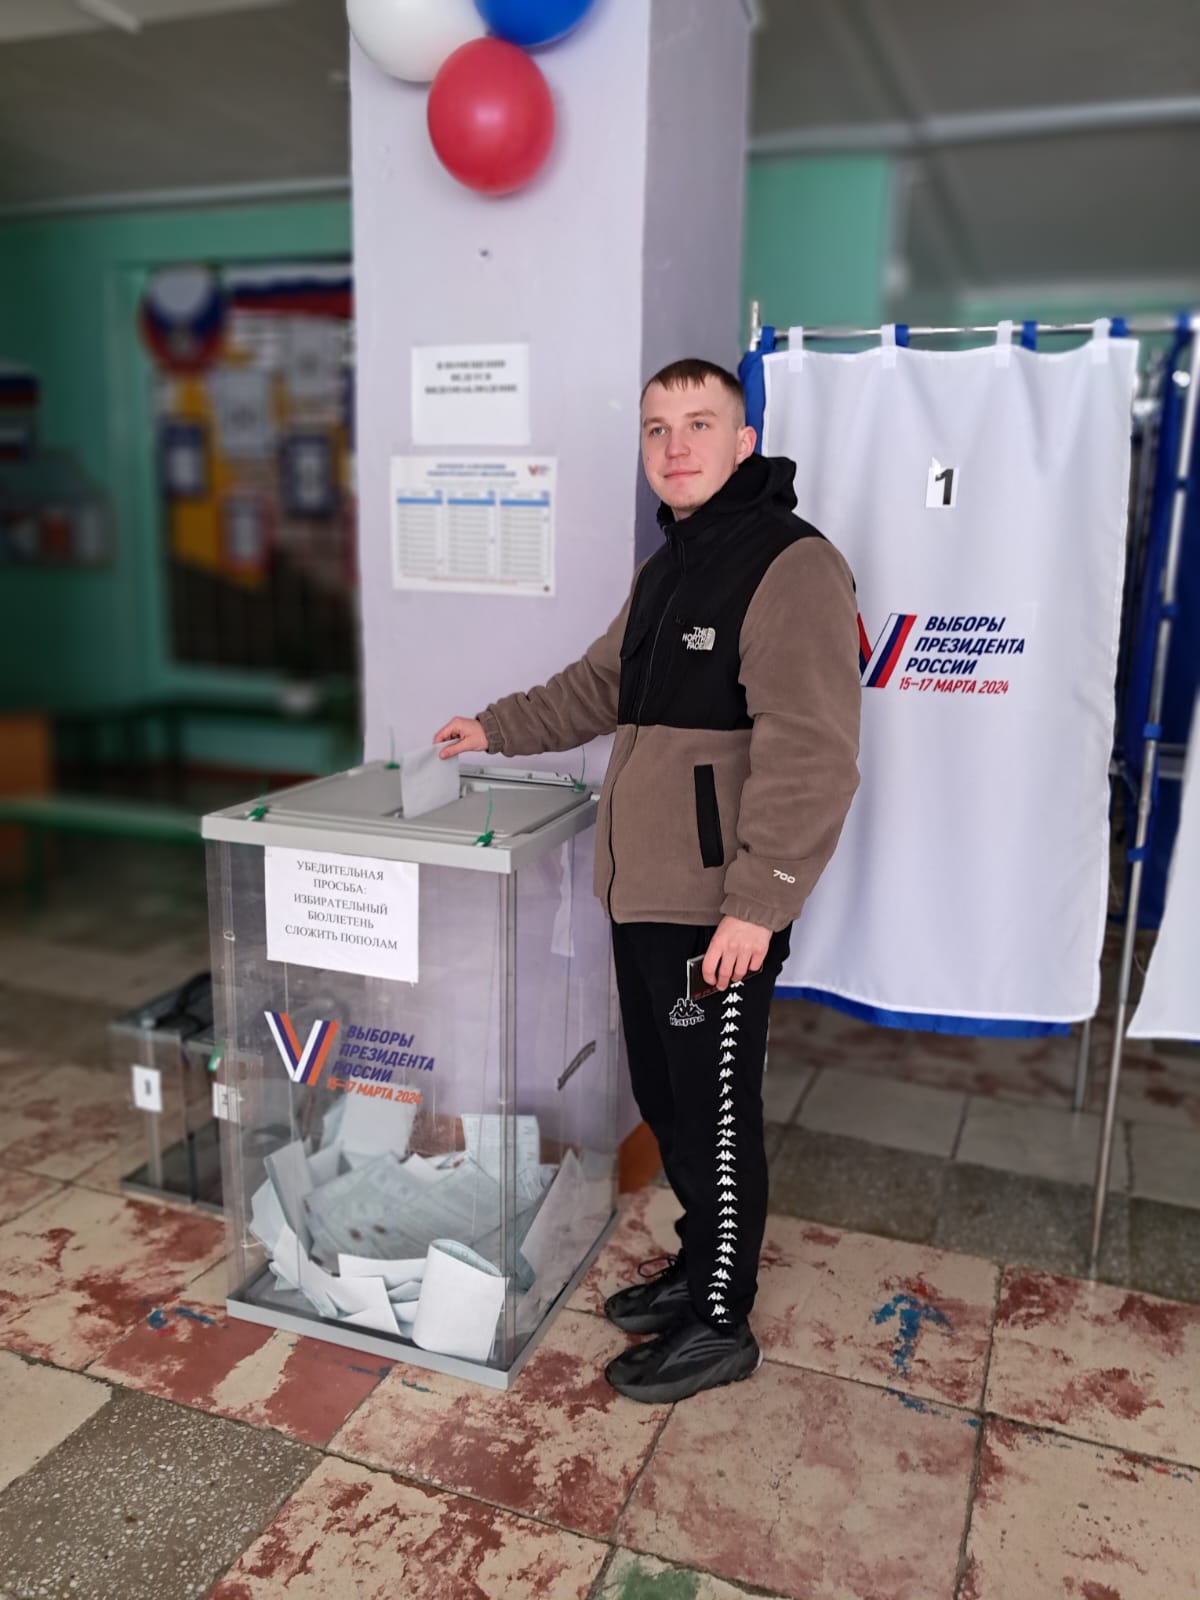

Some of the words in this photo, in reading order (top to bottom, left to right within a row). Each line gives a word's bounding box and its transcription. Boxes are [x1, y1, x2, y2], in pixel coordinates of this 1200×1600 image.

[935, 468, 954, 505] 1
[924, 615, 1006, 633] ВЫБОРЫ
[914, 636, 1025, 655] ПРЕЗИДЕНТА
[905, 657, 978, 674] РОССИИ
[934, 680, 976, 694] МАРТА
[978, 680, 1009, 695] 2024
[296, 860, 384, 881] УБЕДИТЕЛЬНАЯ
[773, 869, 796, 884] 700
[313, 878, 367, 895] ПРОСЬБА:
[294, 893, 389, 915] ИЗБИРАТЕЛЬНЫЙ
[307, 910, 374, 929] БЮЛЛЕТЕНЬ
[285, 924, 338, 941] СЛОЖИТЬ
[340, 932, 398, 950] ПОПОЛАМ
[346, 1024, 415, 1048] ВЫБОРЫ
[338, 1043, 436, 1071] ПРЕЗИДЕНТА
[331, 1060, 393, 1083] РОССИИ
[356, 1084, 393, 1101] МАРТА
